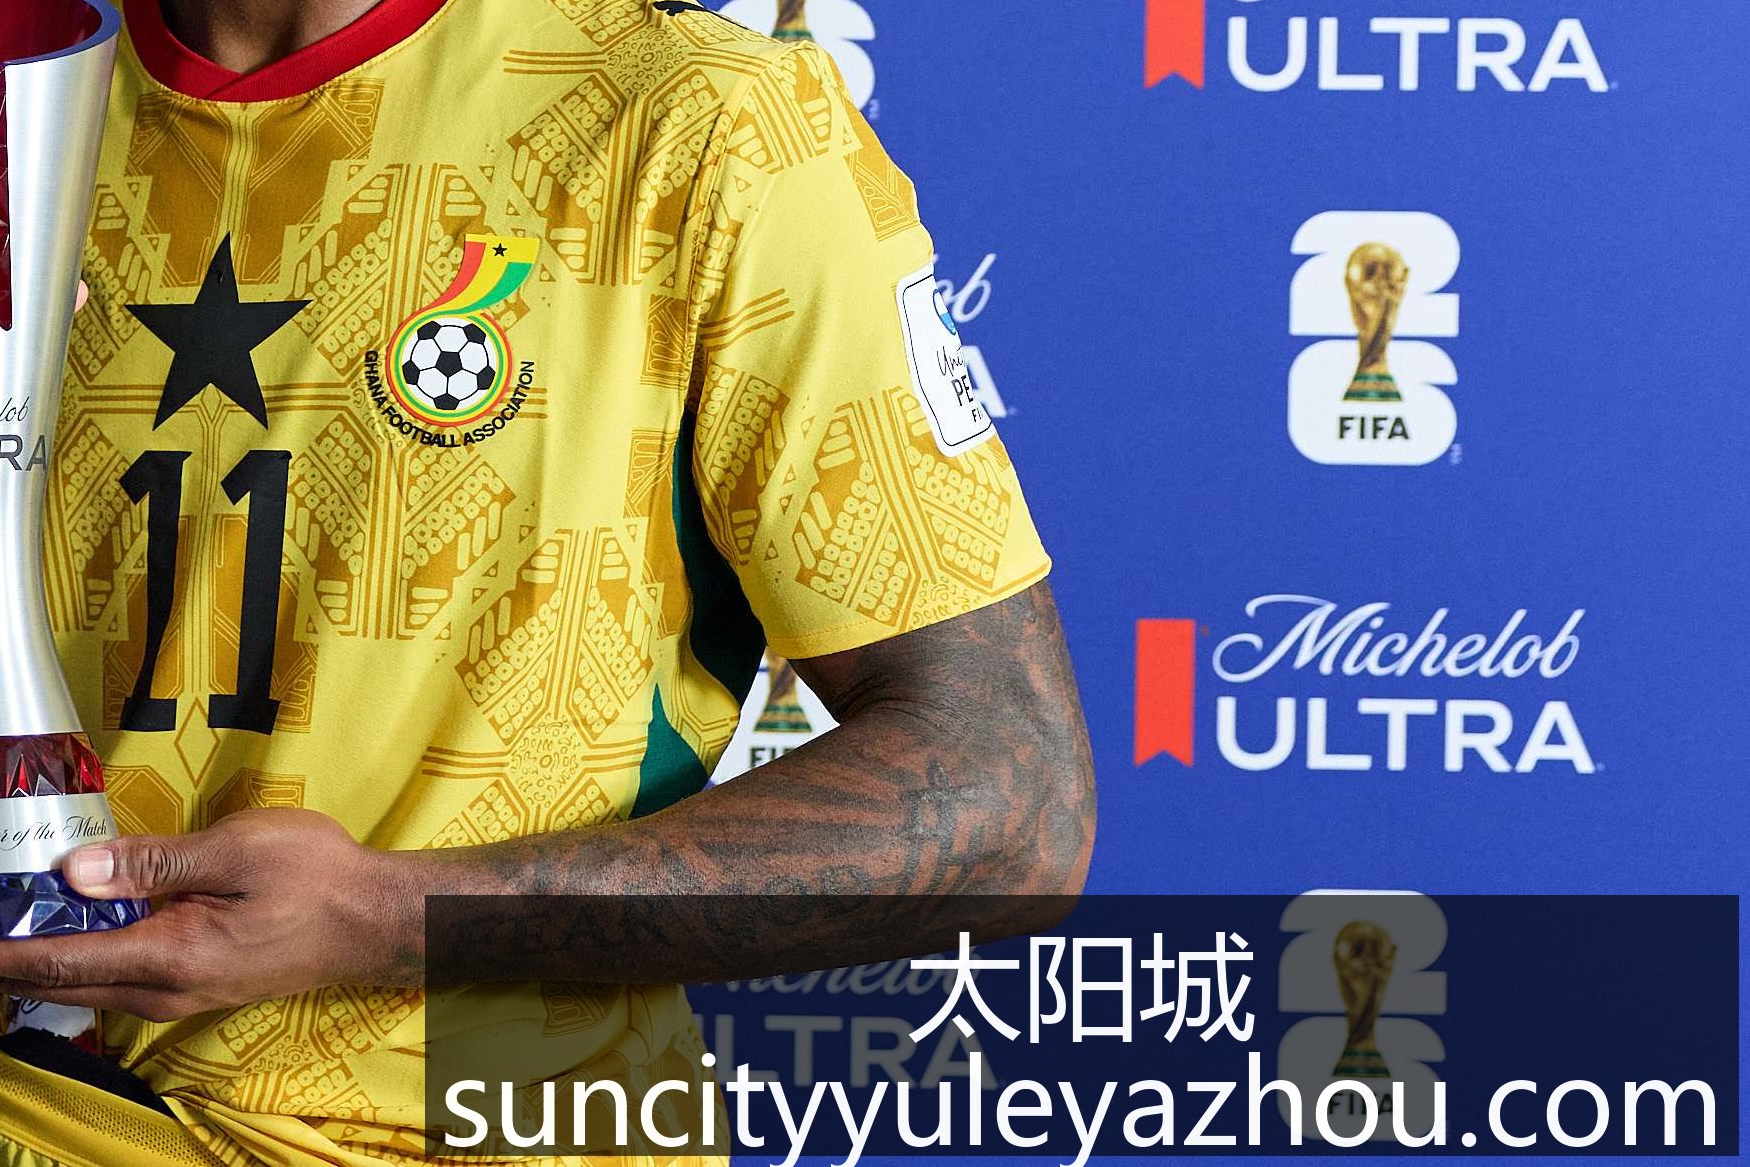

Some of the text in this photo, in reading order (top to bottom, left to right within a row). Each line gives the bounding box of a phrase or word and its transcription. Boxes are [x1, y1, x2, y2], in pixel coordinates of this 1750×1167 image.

[1228, 17, 1609, 92] ULTRA
[364, 349, 536, 448] GHANA FOOTBALL ASSOCIATION
[1338, 416, 1410, 440] FIFA
[118, 449, 293, 736] 11
[1213, 595, 1584, 682] Michelob
[1217, 697, 1595, 773] ULTRA
[2, 826, 32, 851] of
[33, 821, 56, 841] the
[61, 816, 108, 842] Match
[690, 1013, 999, 1091] LTRA
